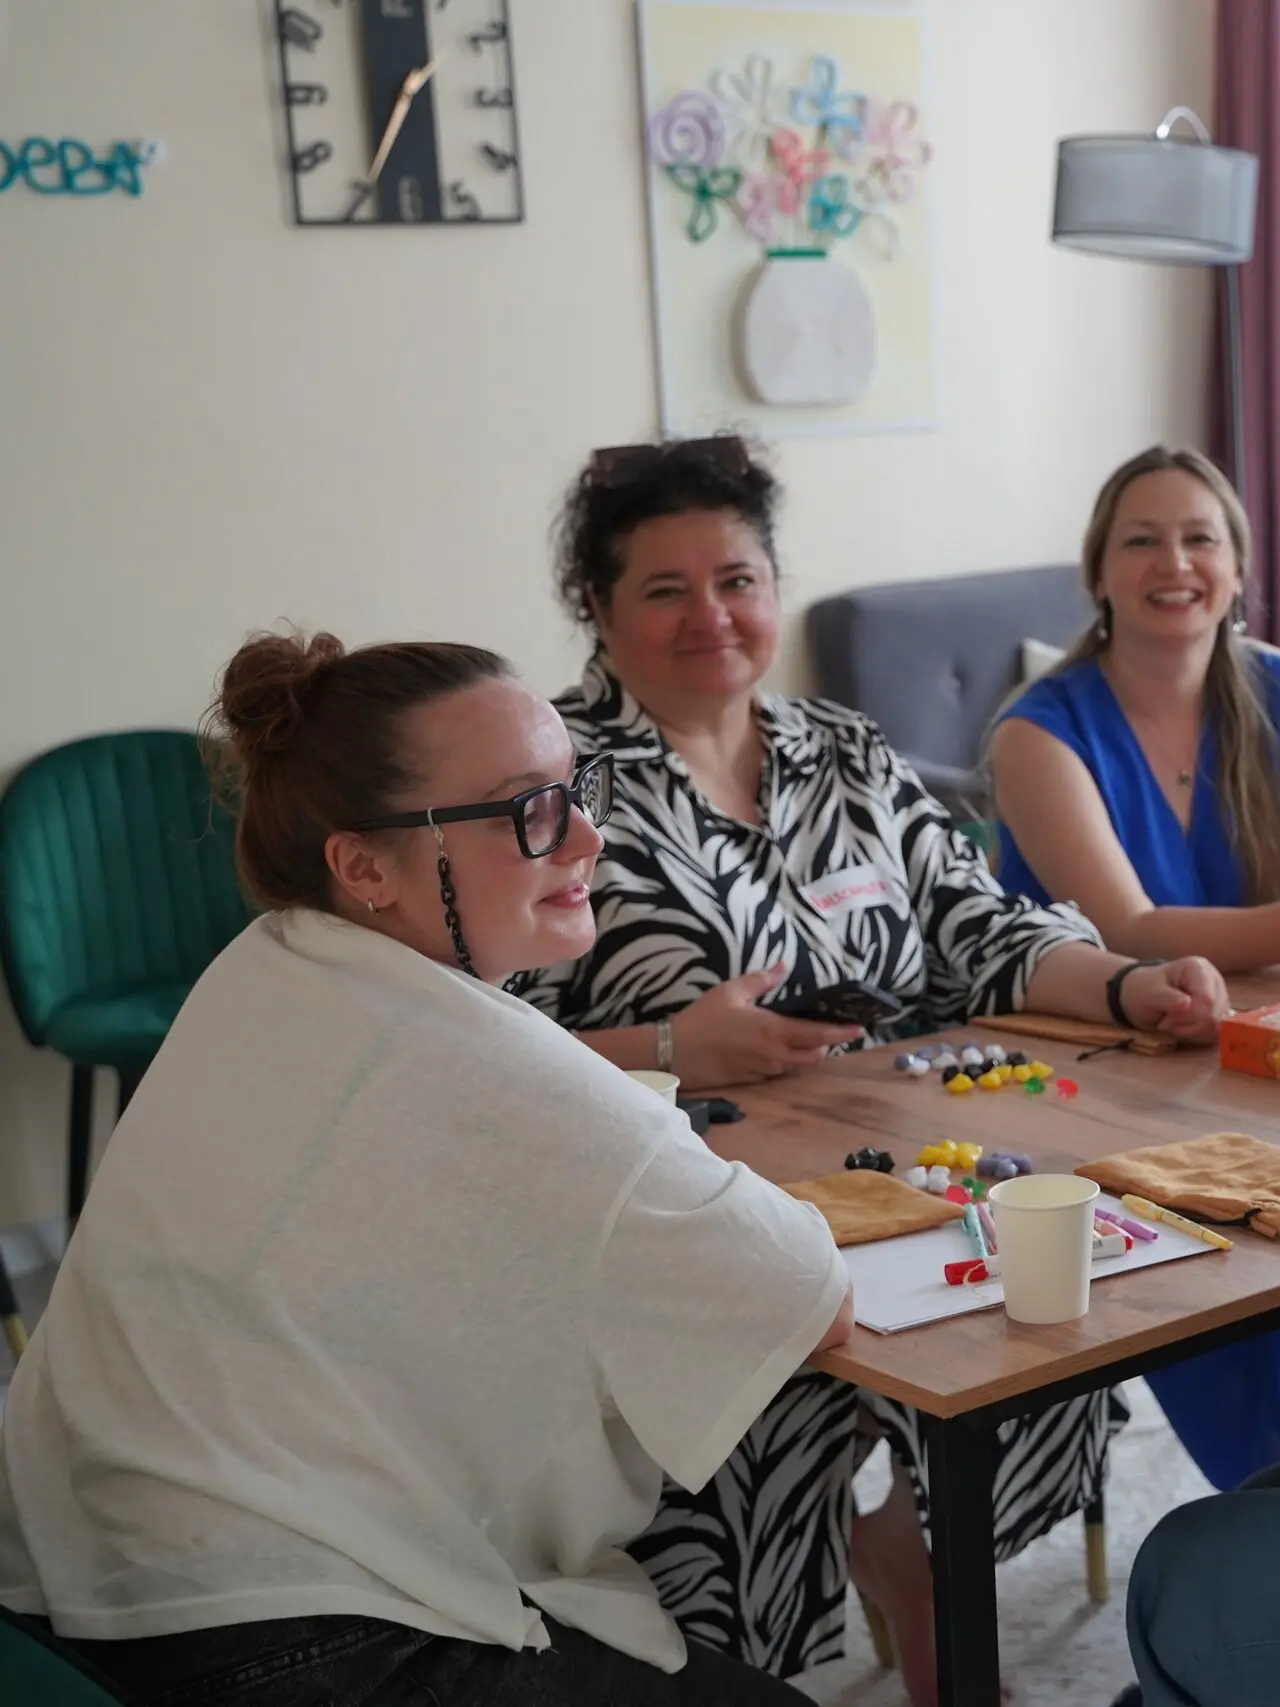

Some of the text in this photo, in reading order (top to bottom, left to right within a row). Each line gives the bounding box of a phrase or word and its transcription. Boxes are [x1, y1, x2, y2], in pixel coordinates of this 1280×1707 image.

[286, 83, 328, 106] 9
[473, 87, 513, 108] 3
[292, 140, 333, 172] 8
